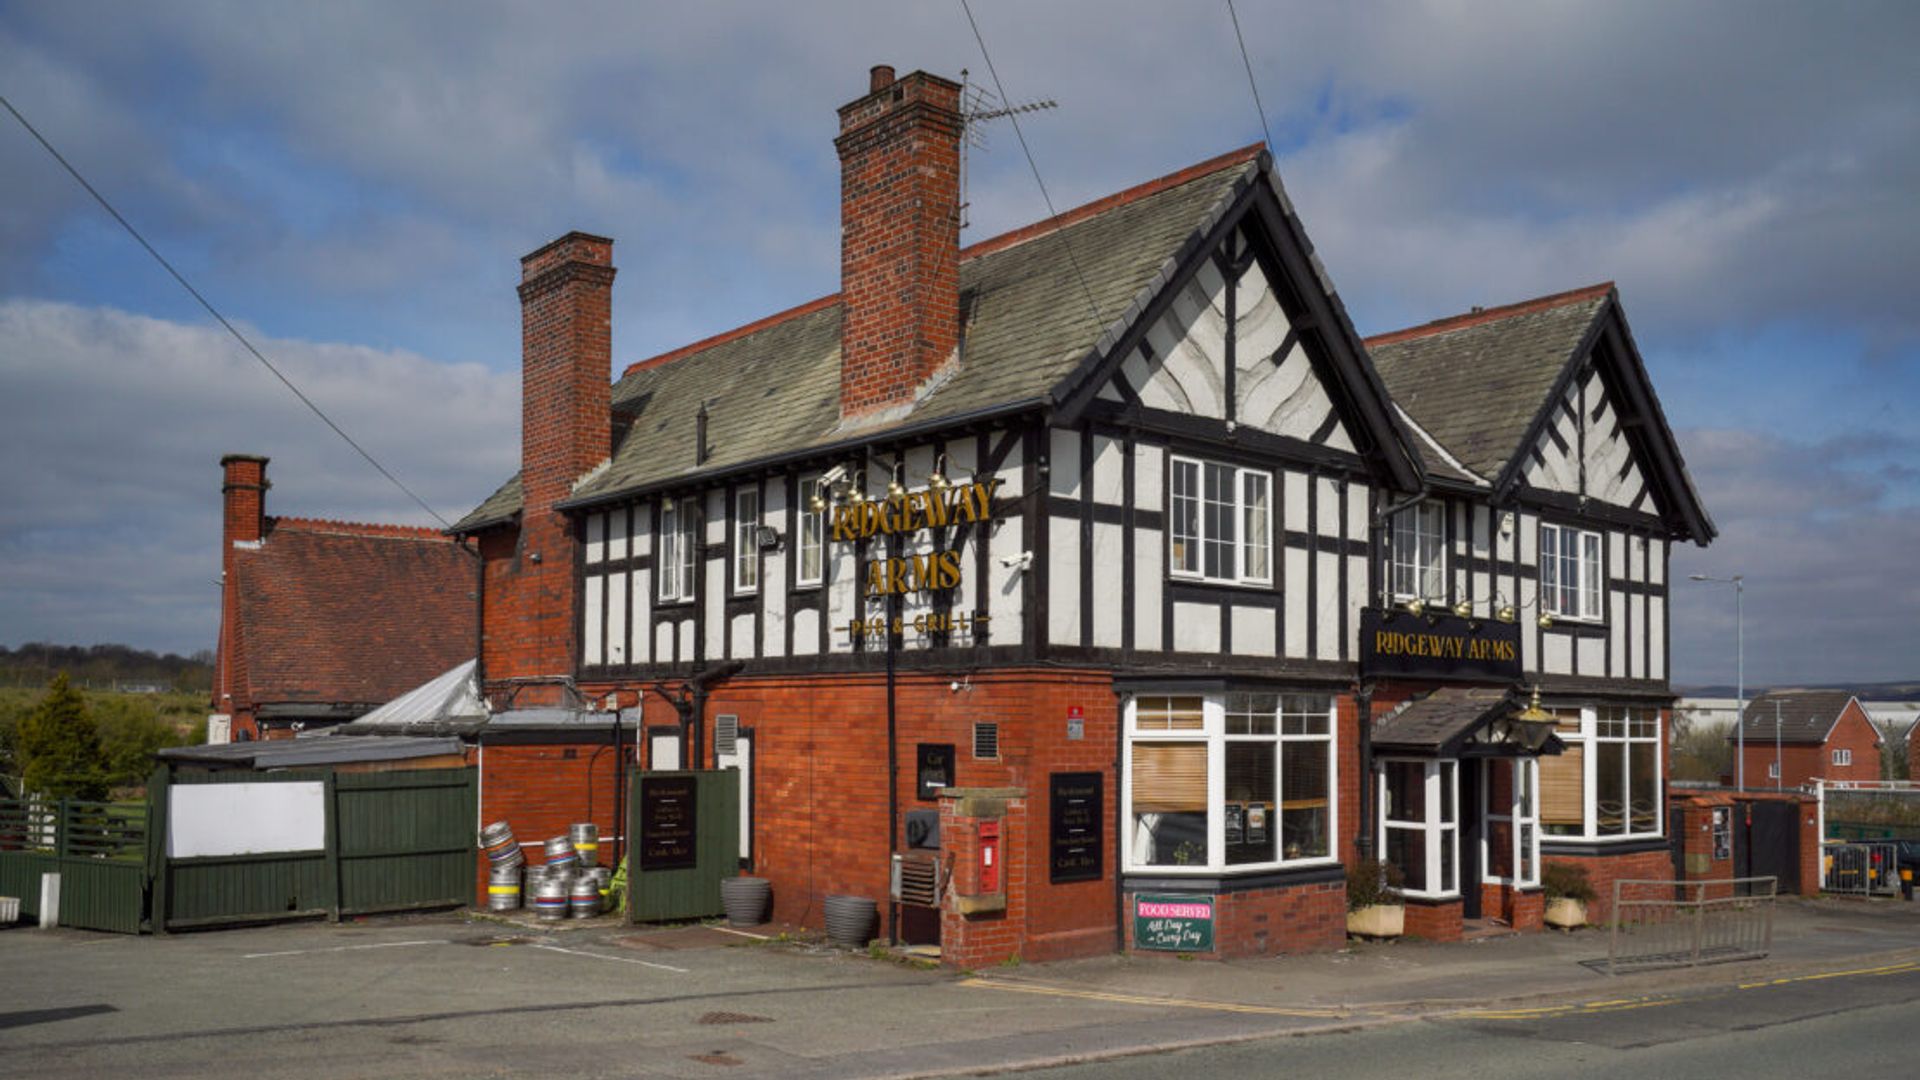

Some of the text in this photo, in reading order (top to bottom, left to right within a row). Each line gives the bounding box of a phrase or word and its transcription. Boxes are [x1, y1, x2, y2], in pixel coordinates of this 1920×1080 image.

[832, 480, 996, 541] RIDGEWAY
[864, 551, 961, 597] ARMS
[851, 611, 970, 637] PUB & GRILL
[1375, 630, 1516, 661] RIDGEWAY ARMS
[1139, 903, 1211, 918] FOOD SERVED
[1164, 919, 1183, 933] Day
[1183, 929, 1202, 945] Day
